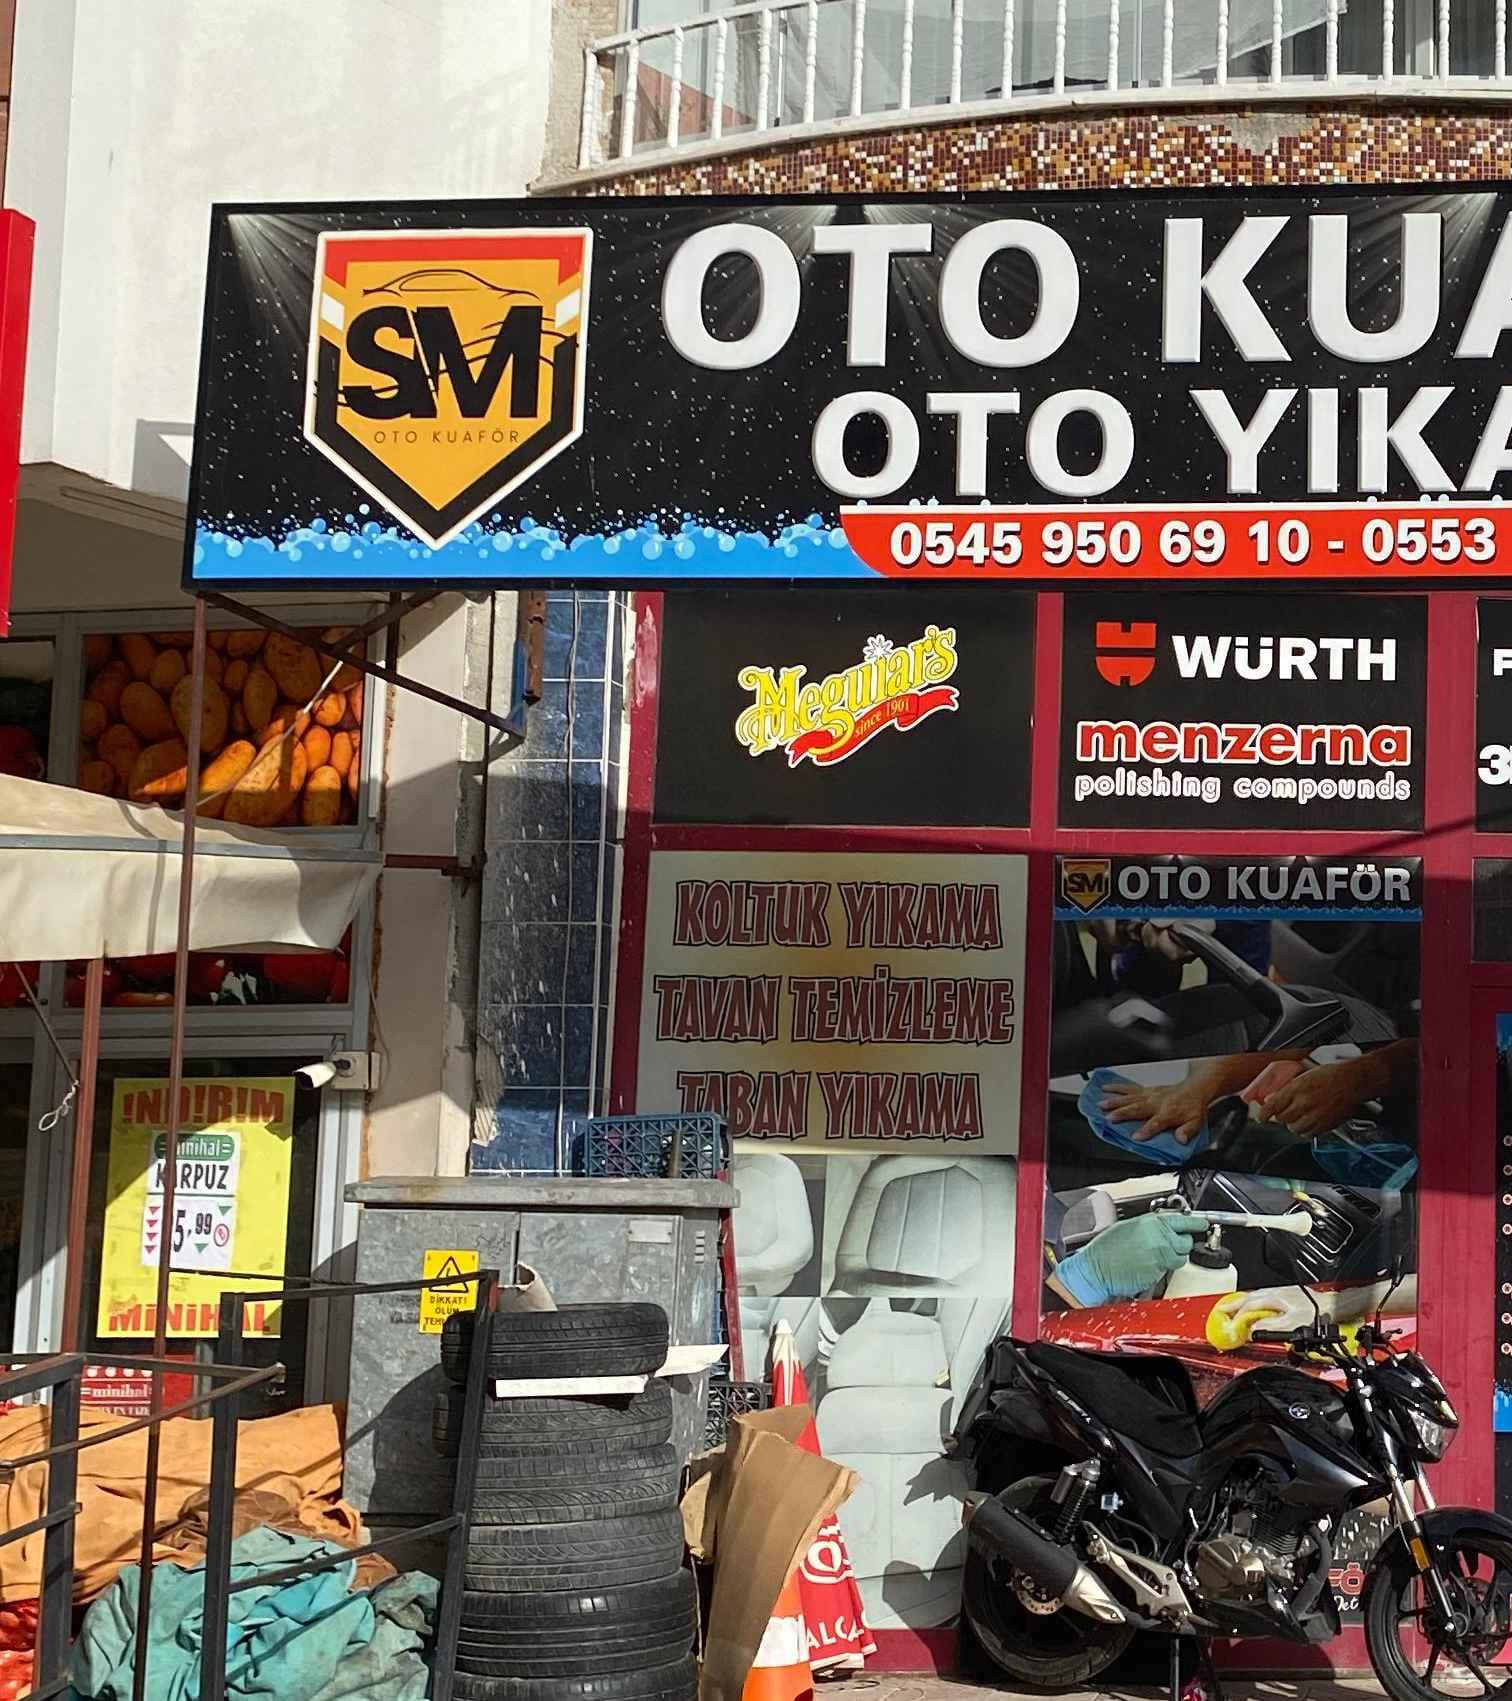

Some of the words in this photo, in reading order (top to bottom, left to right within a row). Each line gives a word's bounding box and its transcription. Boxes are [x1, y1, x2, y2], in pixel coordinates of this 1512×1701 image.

[662, 217, 1080, 370] OTO
[343, 305, 543, 420] SM
[374, 431, 417, 444] OTO
[433, 430, 520, 443] KUAFÖR
[811, 387, 1135, 498] OTO
[891, 521, 1022, 566] 0545
[1042, 520, 1142, 565] 950
[1159, 518, 1226, 563] 69
[1248, 519, 1309, 563] 10
[1361, 517, 1498, 562] 0553
[1171, 635, 1397, 681] WÜRTH
[854, 711, 883, 739] since
[886, 699, 911, 716] 1901
[1076, 720, 1412, 765] menzerna
[1074, 767, 1221, 803] polishing
[1232, 771, 1411, 804] compounds
[1068, 872, 1104, 893] SM
[1117, 865, 1211, 901] OTO
[1228, 863, 1411, 902] KUAFÖR
[673, 880, 831, 947] KOLTUK
[837, 881, 1003, 952] YIKAMA
[653, 974, 781, 1045] TAVAN
[789, 964, 1014, 1046] TEMİZLEME
[677, 1070, 811, 1140] TABAN
[817, 1070, 984, 1141] YIKAMA
[155, 1163, 230, 1190] KRPUZ
